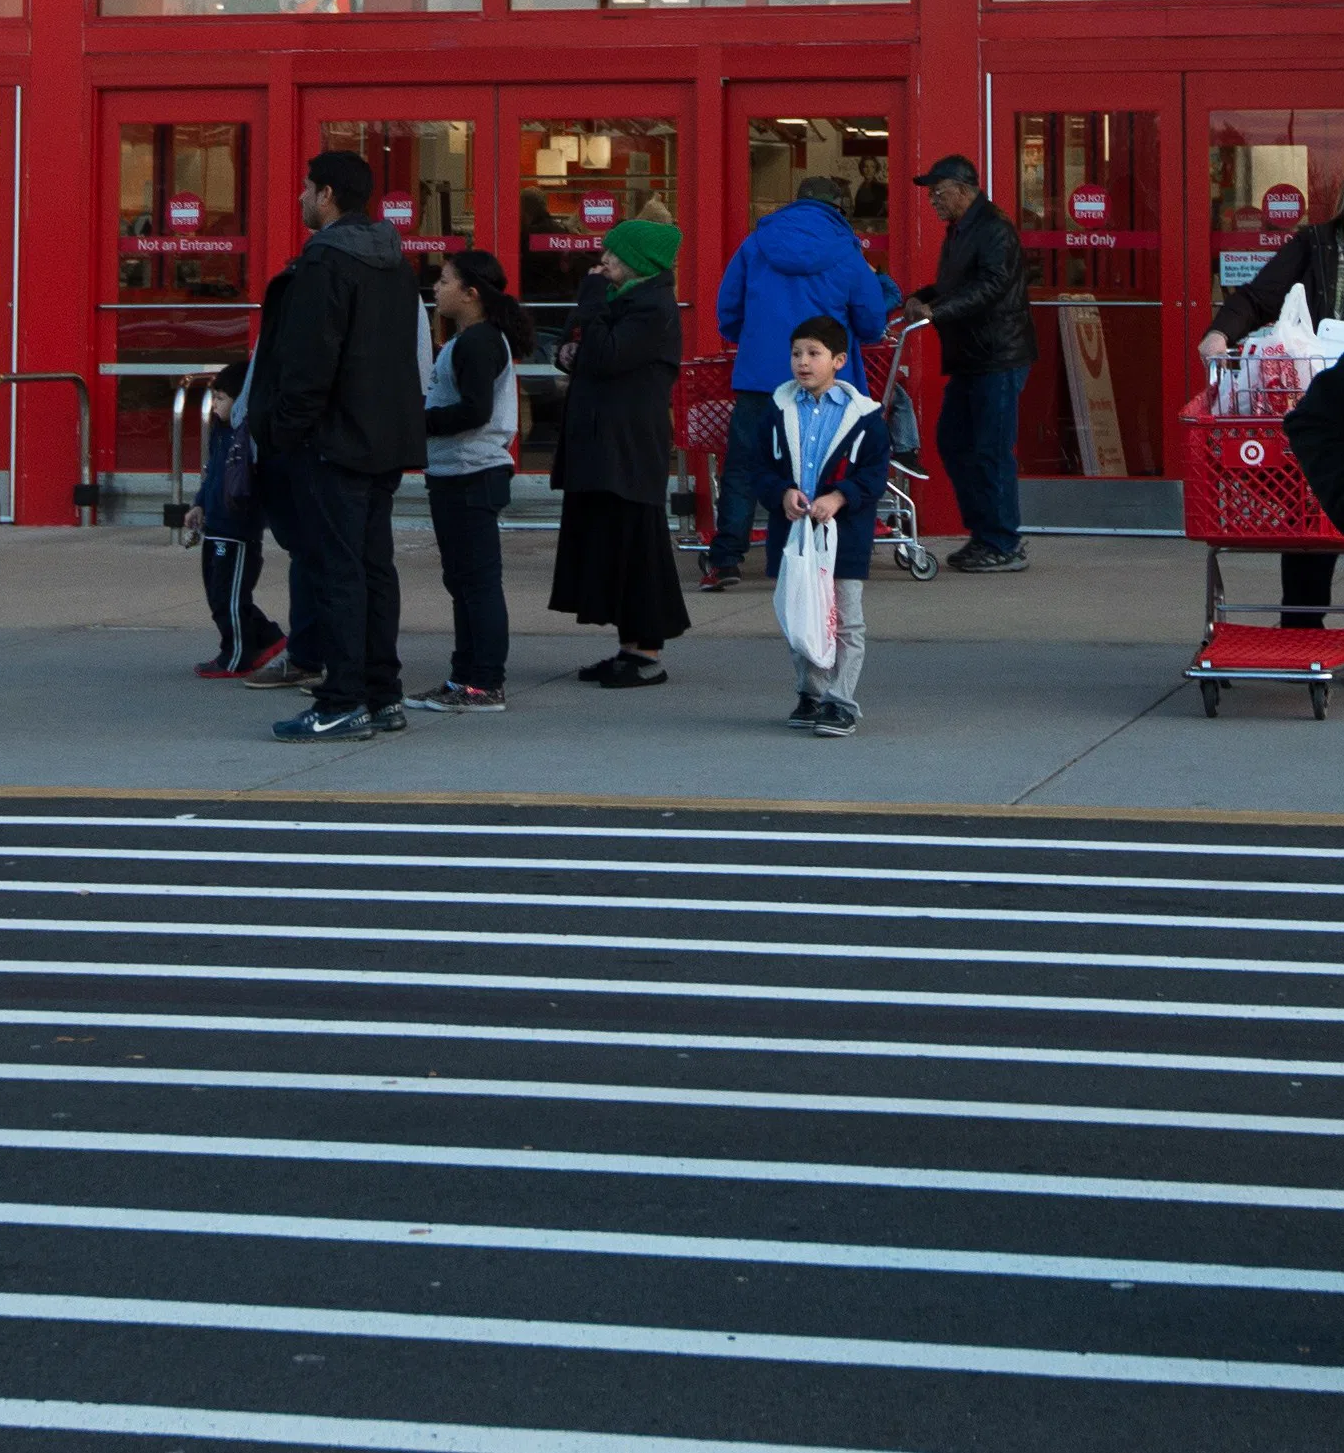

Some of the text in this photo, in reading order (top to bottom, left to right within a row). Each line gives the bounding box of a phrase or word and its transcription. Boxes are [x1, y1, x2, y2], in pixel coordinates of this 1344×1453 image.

[1073, 194, 1105, 203] DO NOT
[1266, 193, 1300, 201] DO NOT
[585, 215, 613, 223] ENTER
[1074, 211, 1104, 219] ENTER
[1268, 210, 1299, 219] ENTER
[137, 239, 233, 250] Not an Entrance
[549, 237, 572, 248] Not
[575, 239, 590, 248] an
[1065, 234, 1116, 248] Exit Only
[1259, 234, 1281, 246] Exit
[400, 240, 446, 250] ntrance
[1224, 254, 1248, 262] Store
